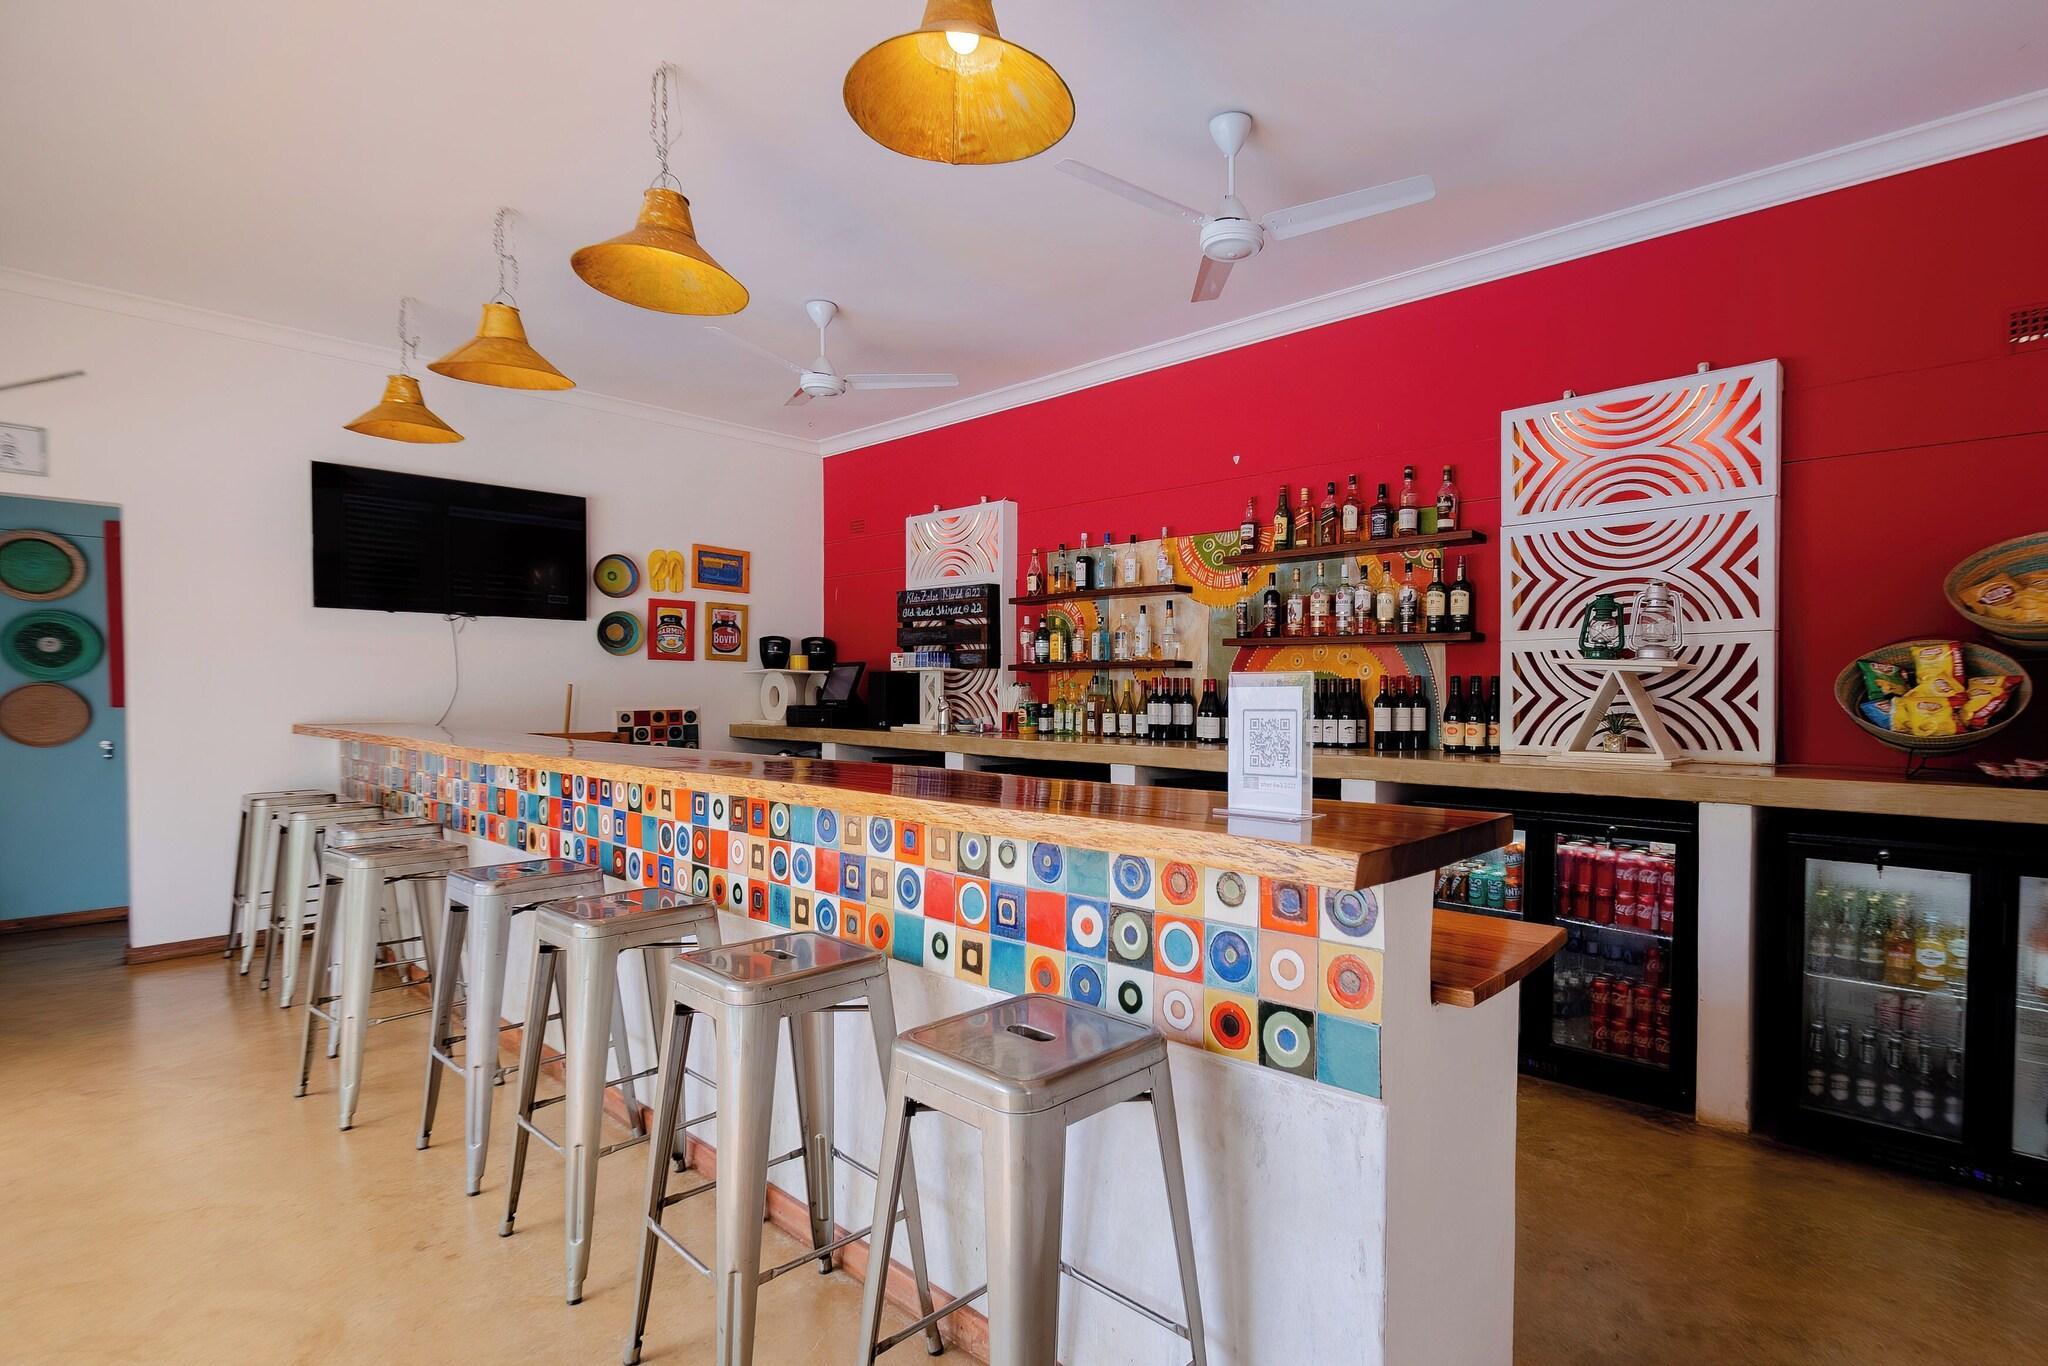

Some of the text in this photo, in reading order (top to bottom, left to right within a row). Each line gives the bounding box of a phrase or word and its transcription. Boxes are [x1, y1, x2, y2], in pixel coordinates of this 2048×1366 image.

[902, 608, 914, 617] Old
[916, 606, 934, 617] Road
[713, 632, 738, 644] Bovril
